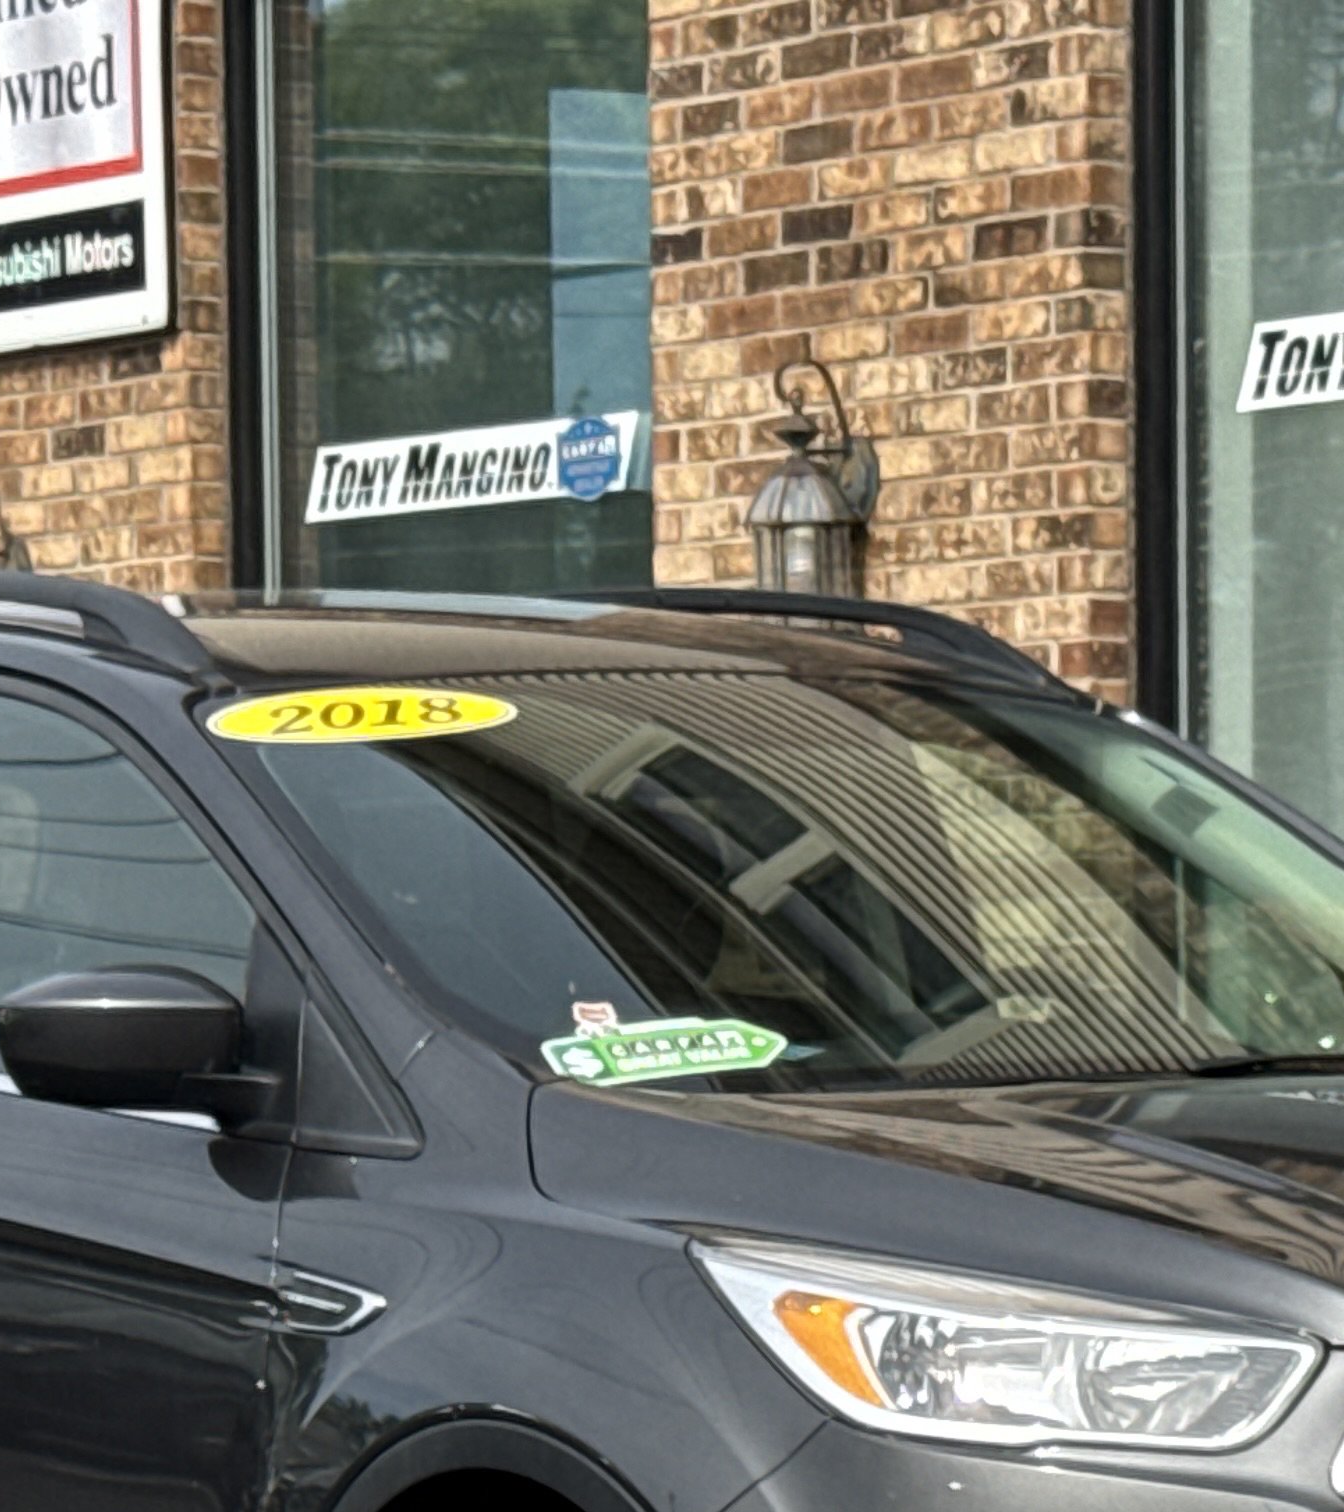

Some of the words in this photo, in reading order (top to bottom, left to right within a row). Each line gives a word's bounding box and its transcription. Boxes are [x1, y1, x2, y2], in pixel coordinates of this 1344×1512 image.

[64, 230, 134, 276] Motors
[317, 453, 401, 513] TONY
[269, 697, 463, 736] 2018
